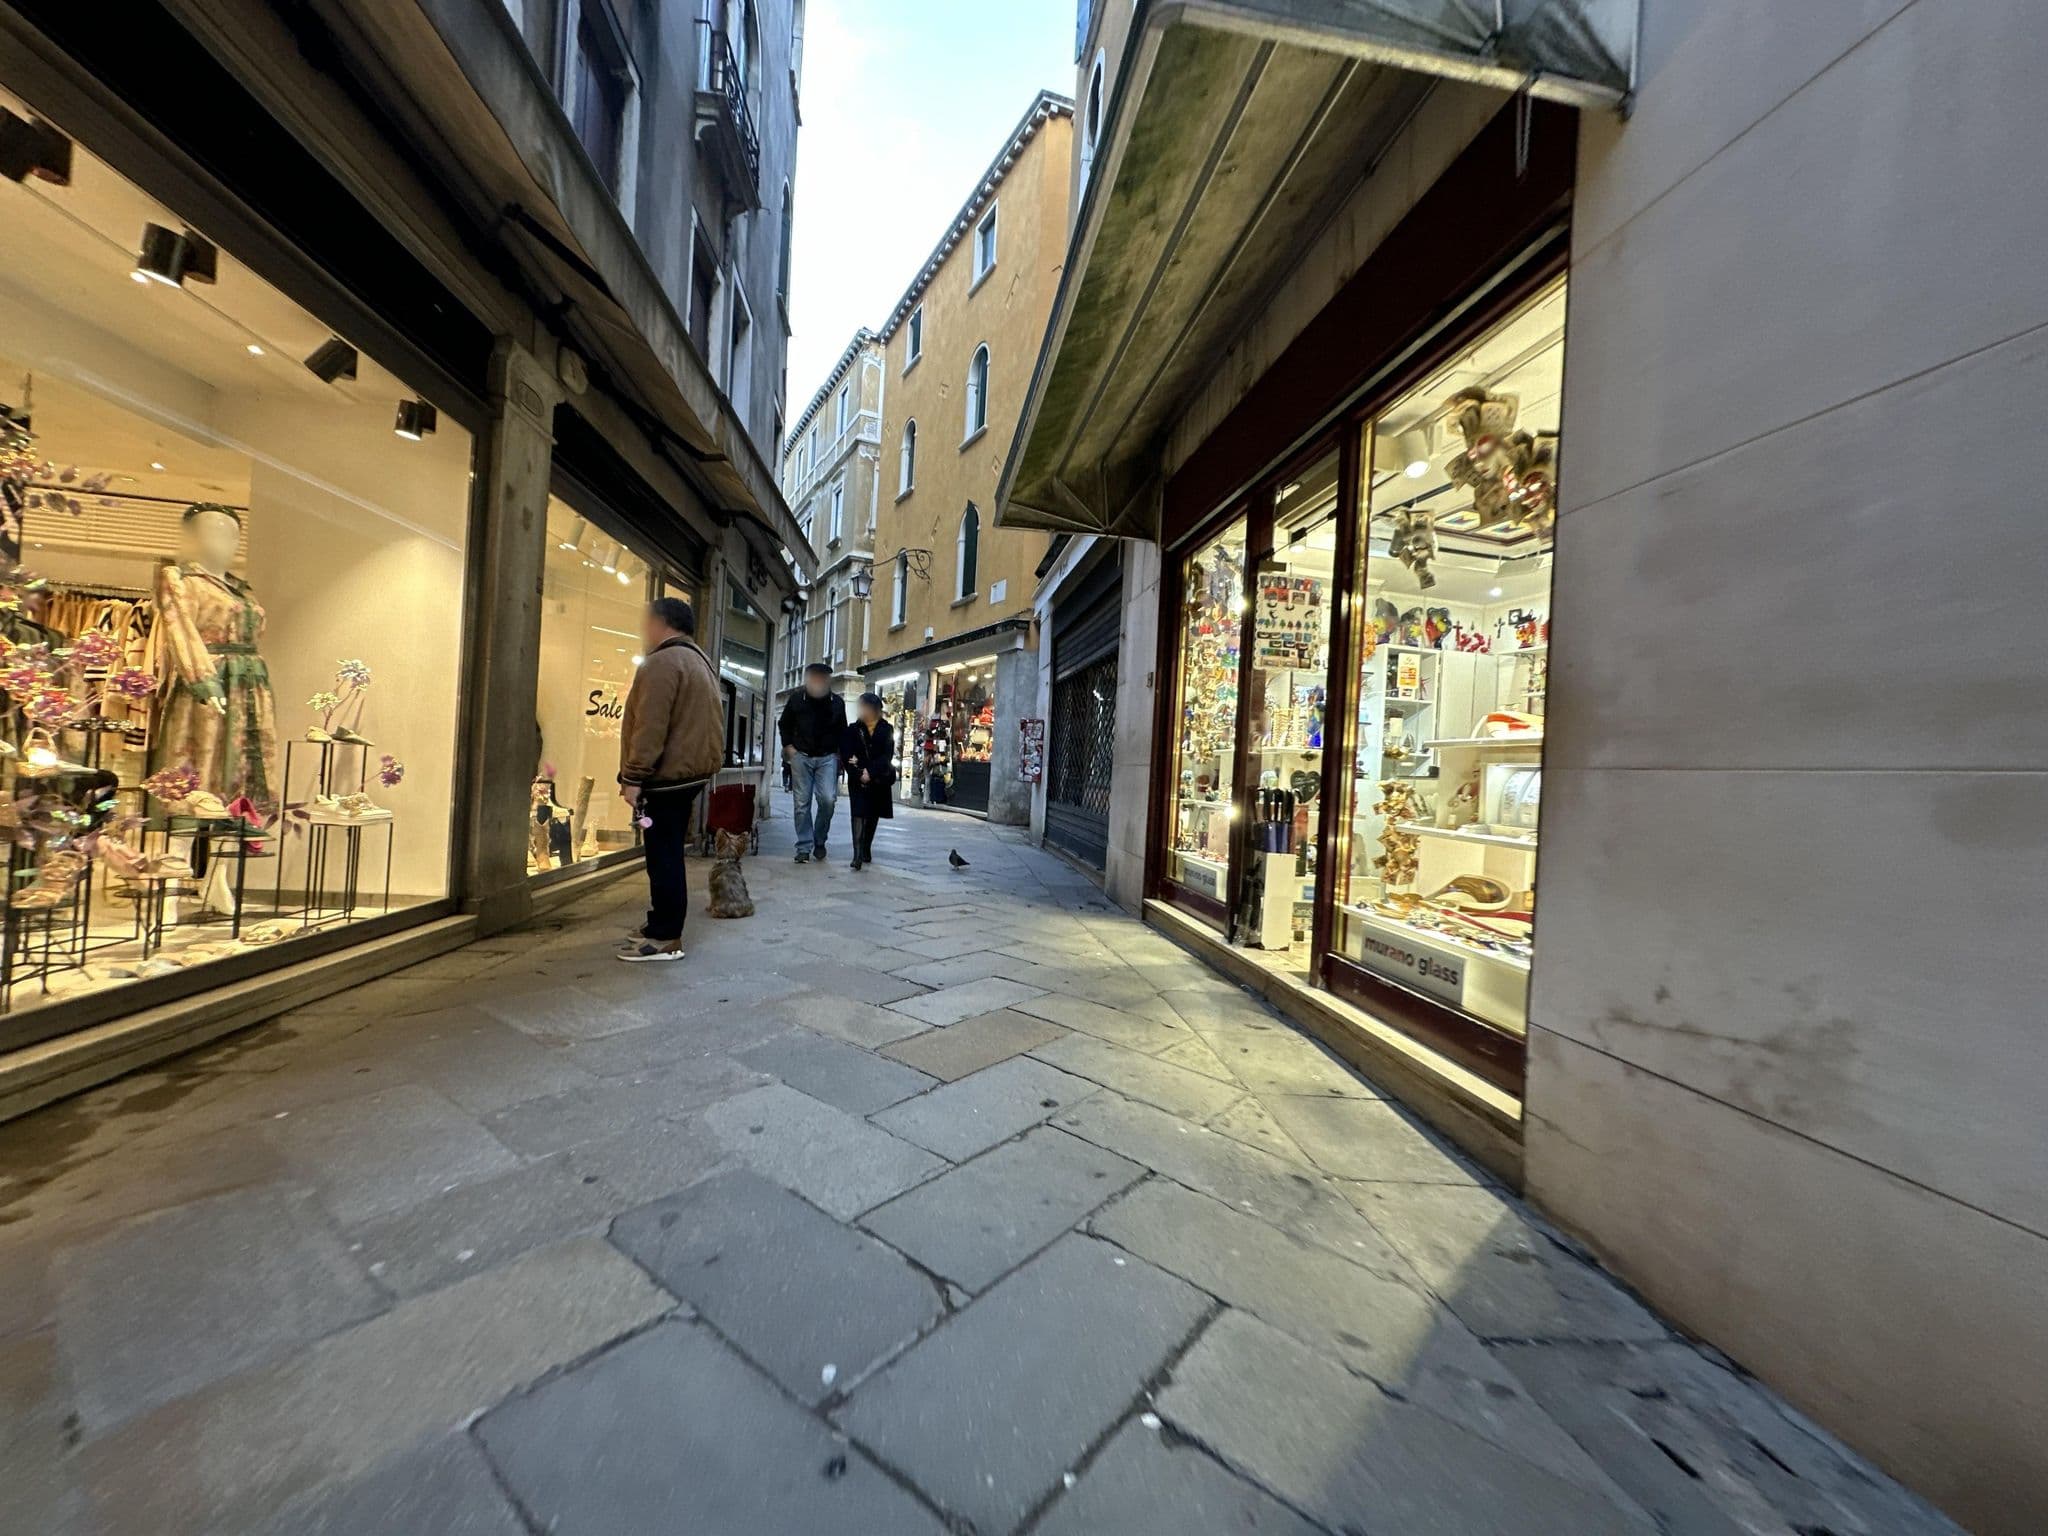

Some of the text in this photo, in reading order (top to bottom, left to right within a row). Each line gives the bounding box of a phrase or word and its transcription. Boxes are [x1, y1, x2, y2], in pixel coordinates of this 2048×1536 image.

[586, 690, 622, 719] Sale
[1364, 936, 1458, 986] murano glass
